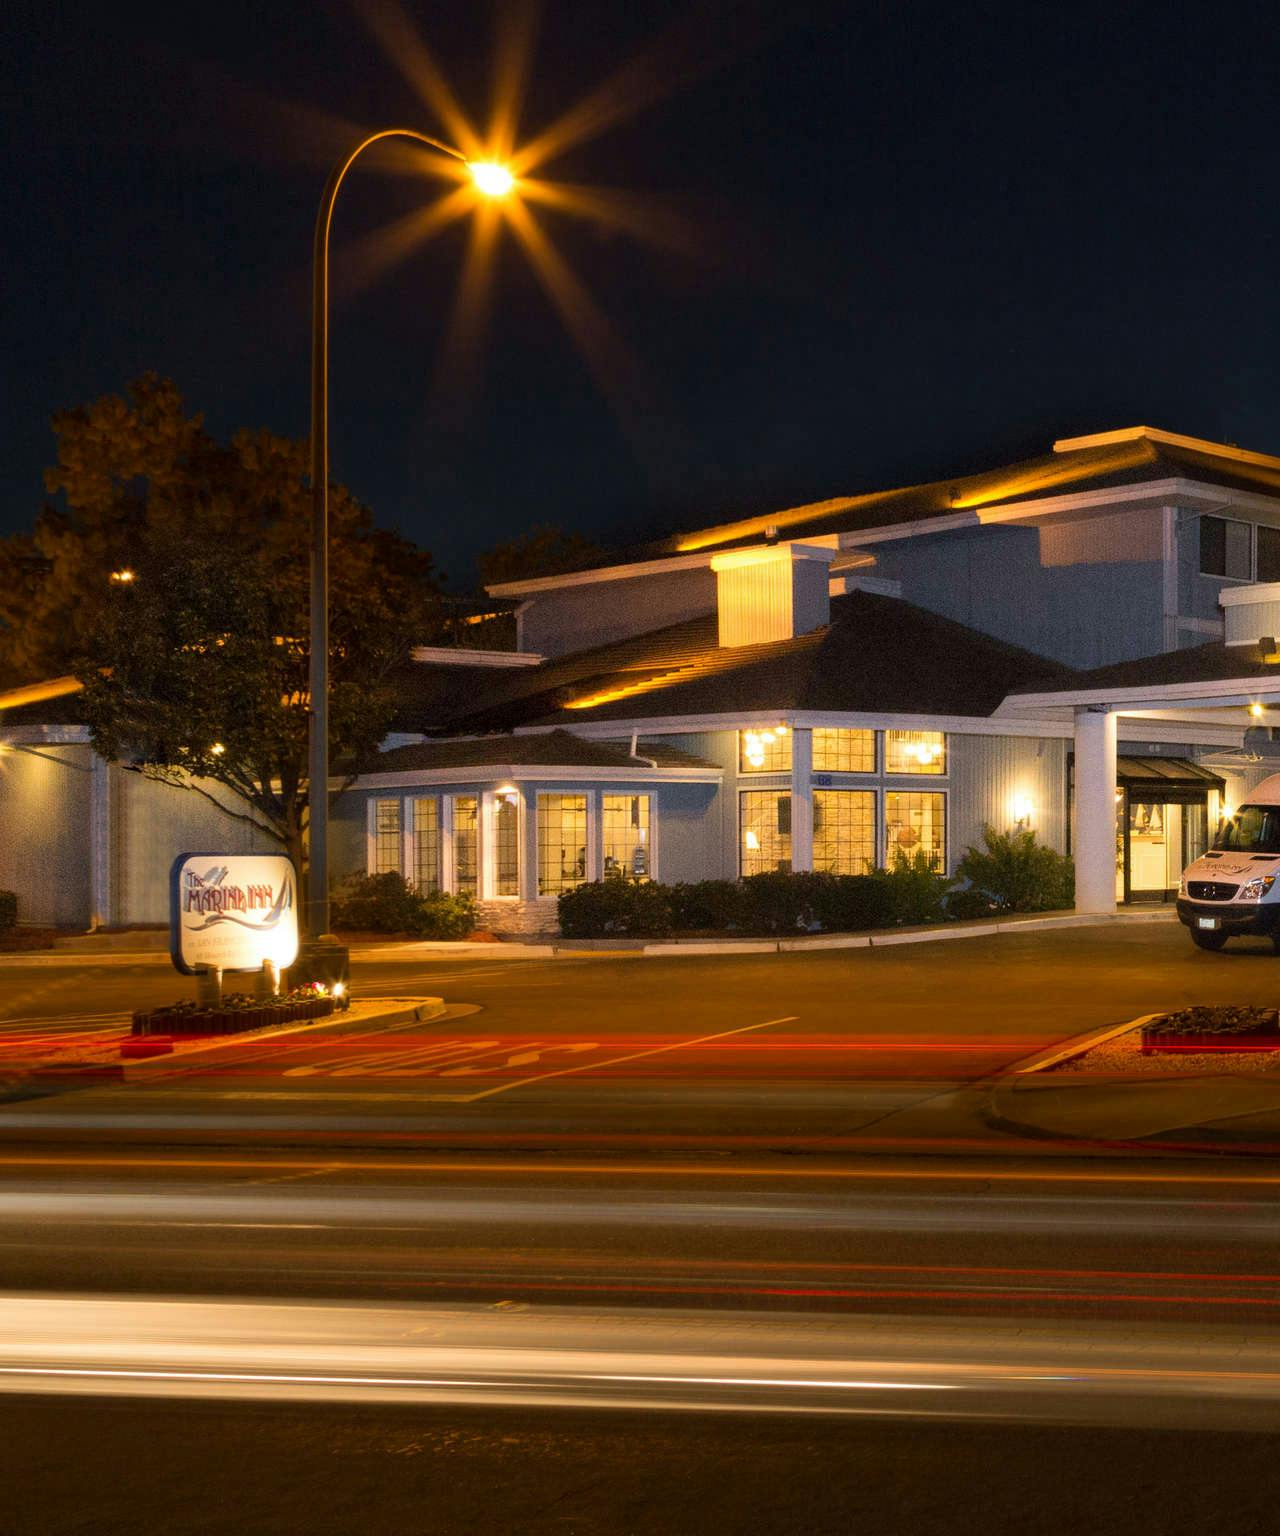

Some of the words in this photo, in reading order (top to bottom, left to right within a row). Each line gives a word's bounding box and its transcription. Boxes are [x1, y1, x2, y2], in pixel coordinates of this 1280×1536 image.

[187, 872, 204, 887] The
[187, 888, 247, 915] MARINA
[248, 885, 273, 909] INN
